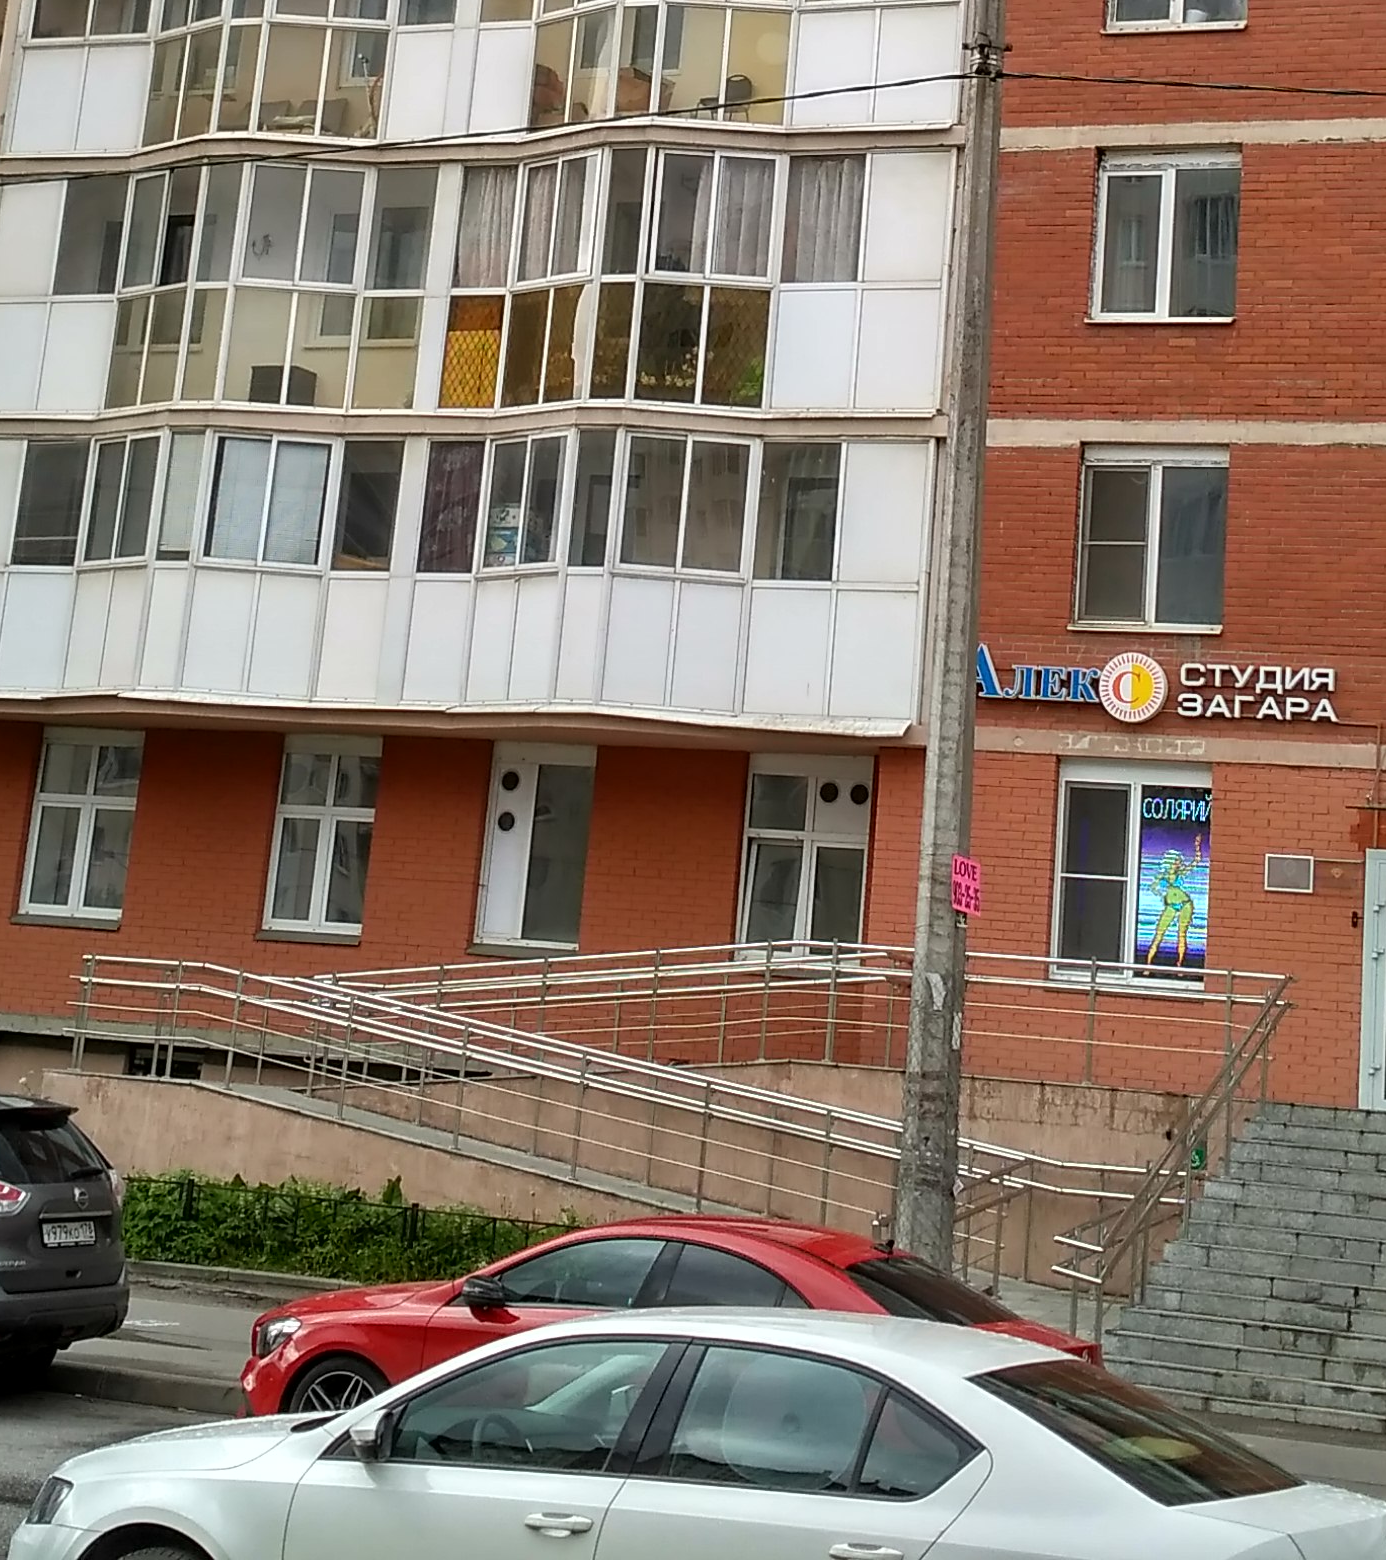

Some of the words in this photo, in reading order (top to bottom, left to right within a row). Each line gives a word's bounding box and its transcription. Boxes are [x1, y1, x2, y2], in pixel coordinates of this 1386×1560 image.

[1179, 663, 1336, 695] СТУДИЯ
[1177, 693, 1340, 723] ЗАГАРА
[1142, 793, 1213, 822] СОЛЯРИЙ
[954, 858, 978, 882] LOVE
